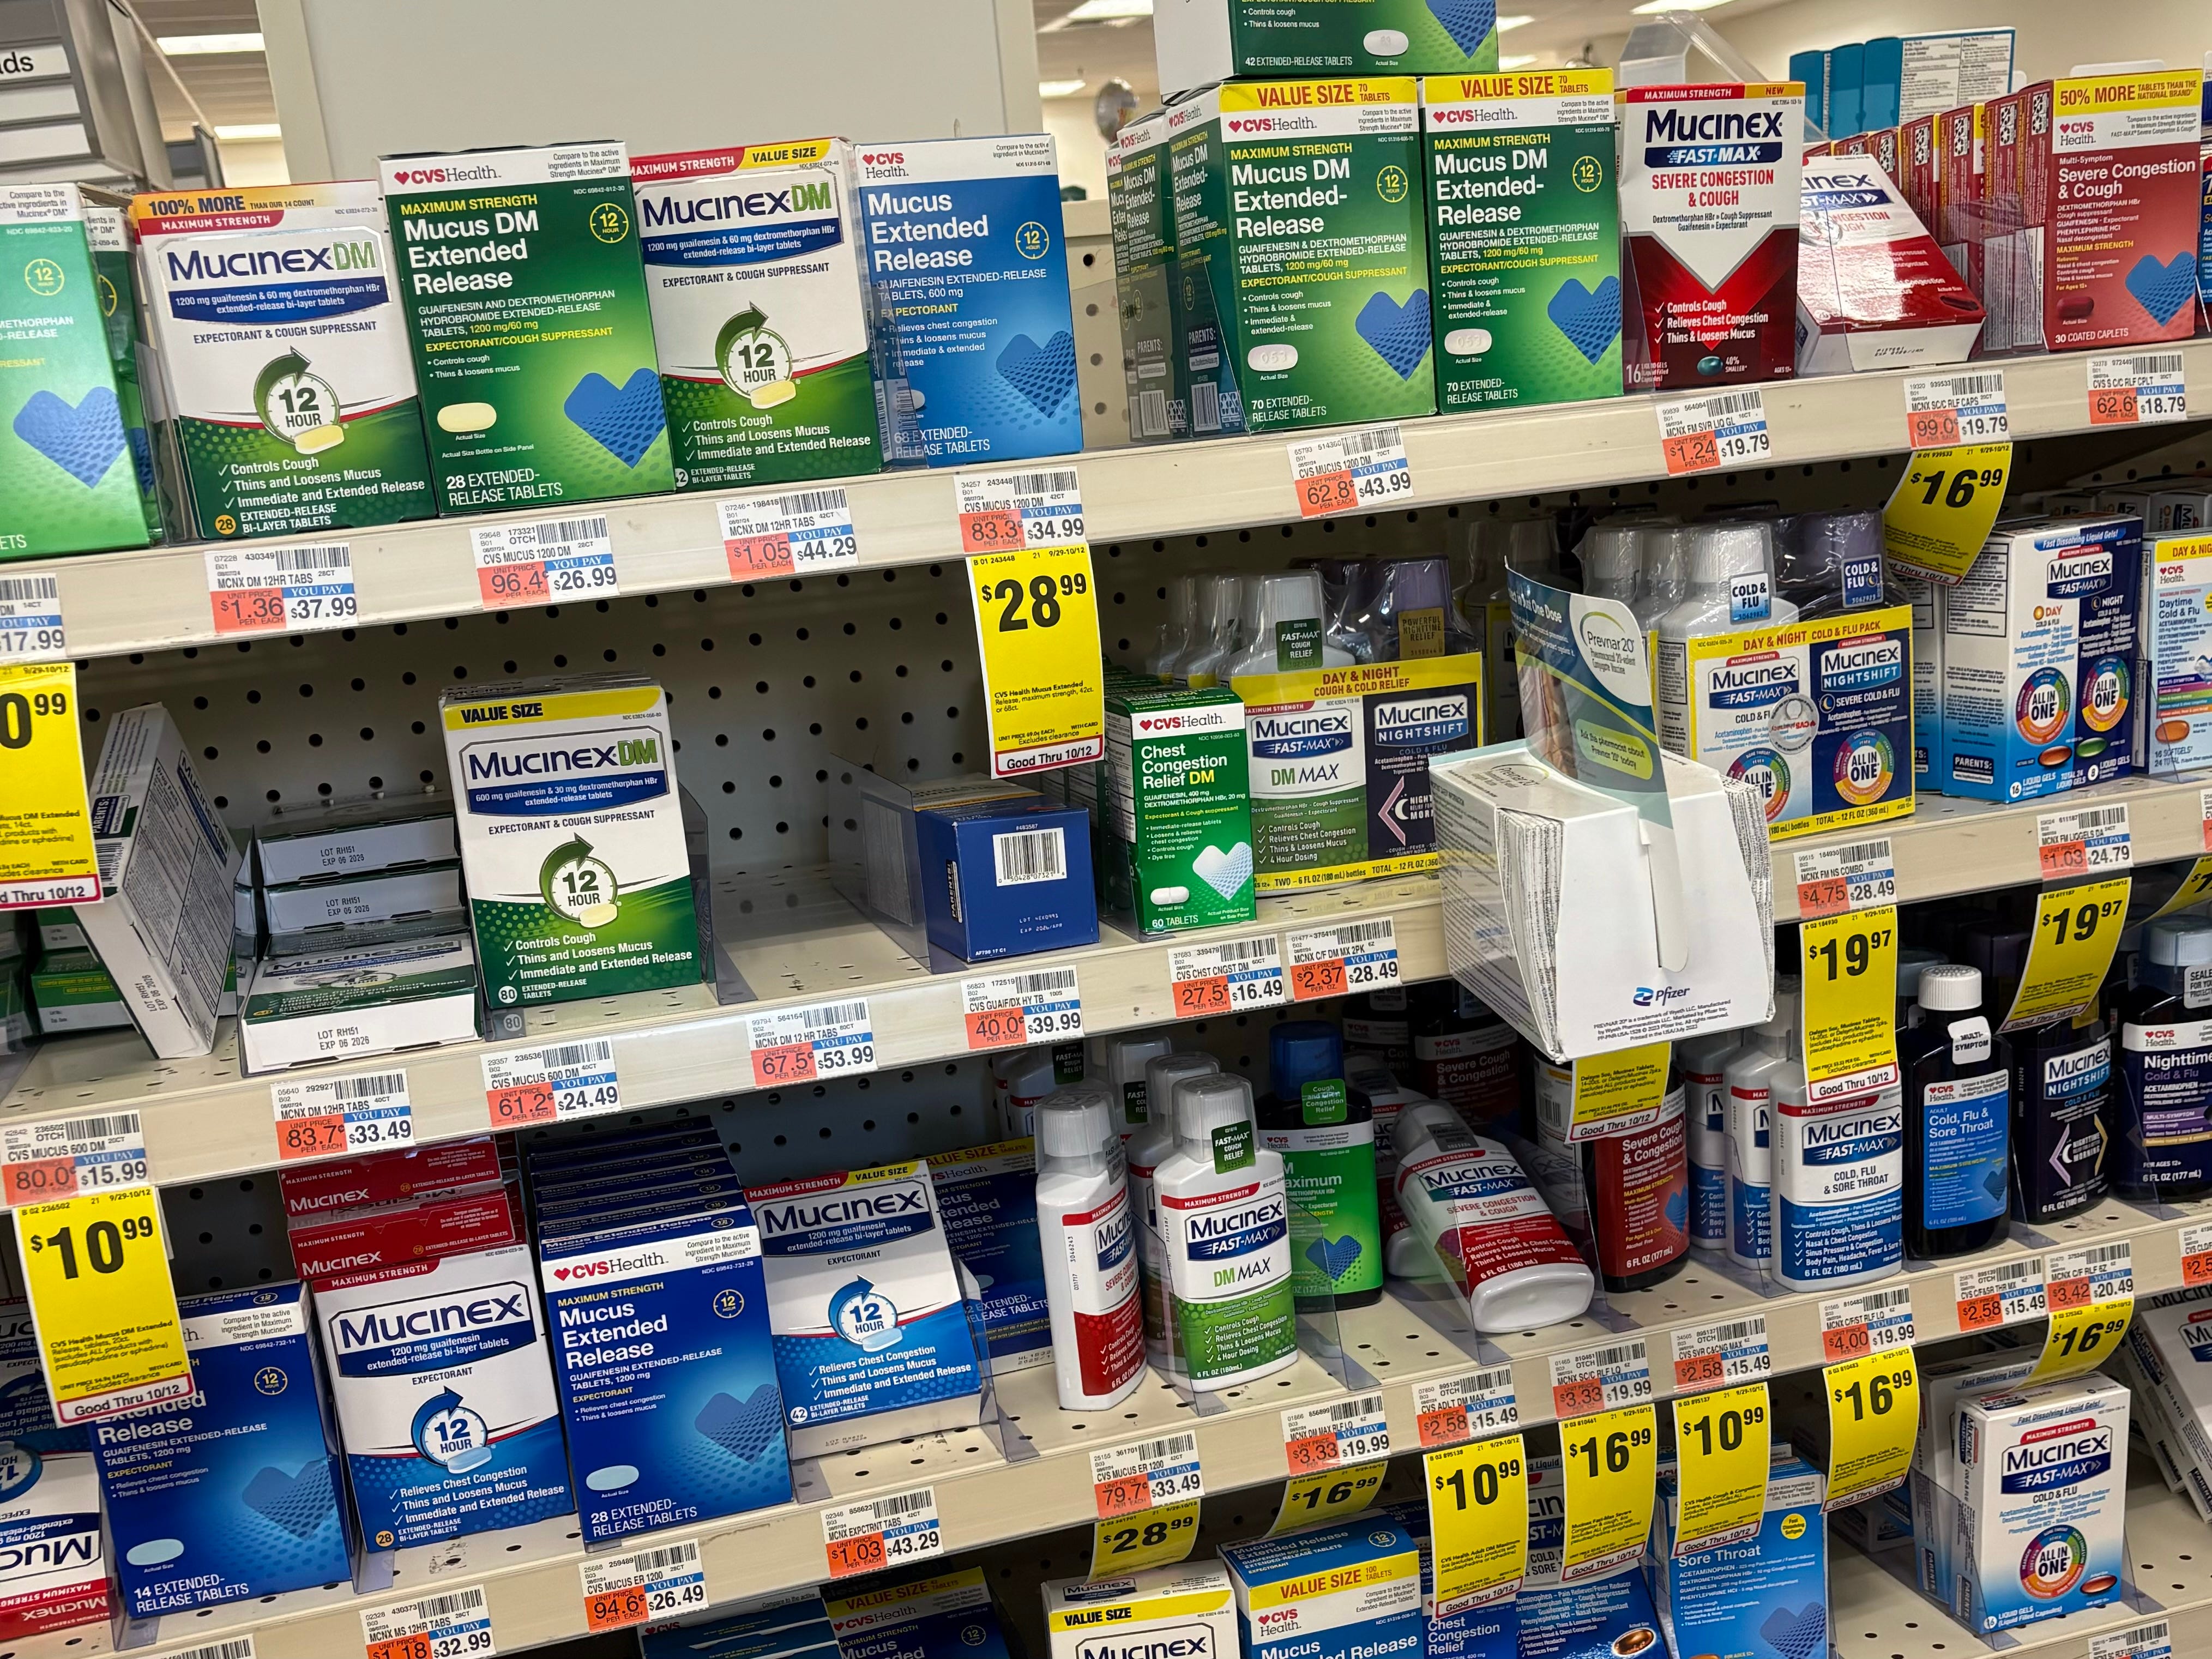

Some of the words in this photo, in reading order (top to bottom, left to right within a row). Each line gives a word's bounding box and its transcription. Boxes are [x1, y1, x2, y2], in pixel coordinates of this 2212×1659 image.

[1257, 57, 1323, 65] EXTENDED-RELEASE
[1324, 57, 1353, 65] TABLETS
[1257, 86, 1313, 106] VALUE
[1318, 85, 1354, 104] SIZE
[1358, 84, 1367, 92] 70
[1360, 93, 1390, 101] TABLETS
[1644, 91, 1687, 99] MAXIMUM
[1690, 89, 1731, 98] STRENGTH
[2060, 89, 2090, 106] 50%
[2095, 85, 2135, 103] MORE
[1646, 109, 1783, 143] Mucinex
[2071, 122, 2094, 132] CVS
[553, 153, 580, 161] Compare
[876, 153, 904, 164] CVS
[2060, 154, 2113, 165] Multi-Symptom
[1652, 172, 1697, 190] SEVERE
[1700, 169, 1774, 187] CONGESTION
[2058, 165, 2107, 183] Severe
[2112, 159, 2196, 180] Congestion
[1689, 192, 1696, 207] &
[1699, 191, 1739, 206] COUGH
[2058, 185, 2068, 198] &
[2073, 181, 2122, 198] Cough
[149, 198, 194, 216] 100%
[198, 196, 245, 213] MORE
[250, 201, 268, 209] THAN
[269, 201, 282, 209] OUR
[293, 199, 315, 207] COUNT
[162, 217, 212, 231] MAXIMUM
[215, 215, 270, 228] STRENGTH
[404, 219, 490, 242] Mucus
[497, 210, 539, 232] DM
[408, 238, 527, 268] Extended
[413, 272, 513, 295] Release
[176, 297, 195, 306] 1200
[197, 297, 210, 306] mg
[212, 292, 257, 305] guaifenesin
[259, 291, 266, 299] &
[267, 291, 277, 299] 60
[279, 291, 292, 299] mg
[293, 285, 364, 299] dextromethorphan
[366, 283, 379, 292] HBr
[1626, 365, 1641, 384] 16
[279, 388, 320, 413] 12
[286, 413, 322, 429] HOUR
[446, 476, 465, 489] 28
[468, 468, 540, 487] EXTENDED-
[449, 486, 505, 506] RELEASE
[507, 482, 563, 500] TABLETS
[2043, 538, 2054, 548] Fast
[2086, 530, 2103, 542] Liquid
[1049, 547, 1085, 558] 9/29-10/12
[2050, 558, 2110, 581] Mucinex
[218, 577, 244, 588] MCNX
[247, 576, 261, 587] DM
[263, 575, 285, 586] 12HR
[287, 574, 313, 584] TABS
[291, 586, 314, 596] YOU
[316, 584, 343, 595] PAY
[2101, 595, 2123, 606] NIGHT
[2159, 597, 2192, 611] Daytime
[2046, 606, 2063, 617] DAY
[1323, 674, 1347, 685] DAY
[1350, 673, 1359, 682] &
[1363, 667, 1400, 680] NIGHT
[461, 707, 508, 723] VALUE
[511, 702, 543, 718] SIZE
[1379, 702, 1464, 726] Mucinex
[1378, 722, 1463, 742] NIGHTSHIFT
[1007, 758, 1036, 770] Good
[1038, 753, 1062, 765] Thru
[1065, 746, 1092, 759] 10/12
[1141, 743, 1186, 759] Chest
[1142, 755, 1227, 776] Congestion
[1271, 768, 1295, 786] DM
[1298, 763, 1339, 783] MAX
[1143, 773, 1185, 789] Relief
[1189, 769, 1214, 785] DM
[1152, 919, 1164, 928] 60
[1166, 915, 1198, 926] TABLETS
[1655, 986, 1690, 1006] Pfizer
[318, 1030, 335, 1040] LOT
[320, 1041, 335, 1050] EXP
[339, 1039, 348, 1047] 06
[352, 1036, 370, 1046] 2026
[1955, 1039, 1989, 1052] SYMPTOM
[1929, 1113, 1958, 1127] Cold,
[1961, 1109, 1979, 1123] Flu
[1981, 1107, 1989, 1118] &
[1623, 1131, 1658, 1151] Severe
[1660, 1119, 1684, 1141] Cough
[1929, 1125, 1958, 1138] Sore
[1961, 1118, 1993, 1134] Throat
[1623, 1153, 1632, 1165] &
[1635, 1133, 1682, 1164] Congestion
[764, 1190, 924, 1234] Mucinex
[1189, 1202, 1282, 1240] Mucinex
[332, 1273, 377, 1287] MAXIMUM
[379, 1264, 428, 1279] STRENGTH
[339, 1294, 525, 1348] Mucinex
[559, 1302, 635, 1328] Mucus
[563, 1314, 668, 1349] Extended
[566, 1343, 654, 1370] Release
[819, 1361, 857, 1374] Relieves
[858, 1356, 883, 1367] Chest
[886, 1345, 936, 1363] Congestion
[2006, 1434, 2107, 1473] Mucinex
[590, 1512, 608, 1524] 28
[611, 1499, 677, 1520] EXTENDED-
